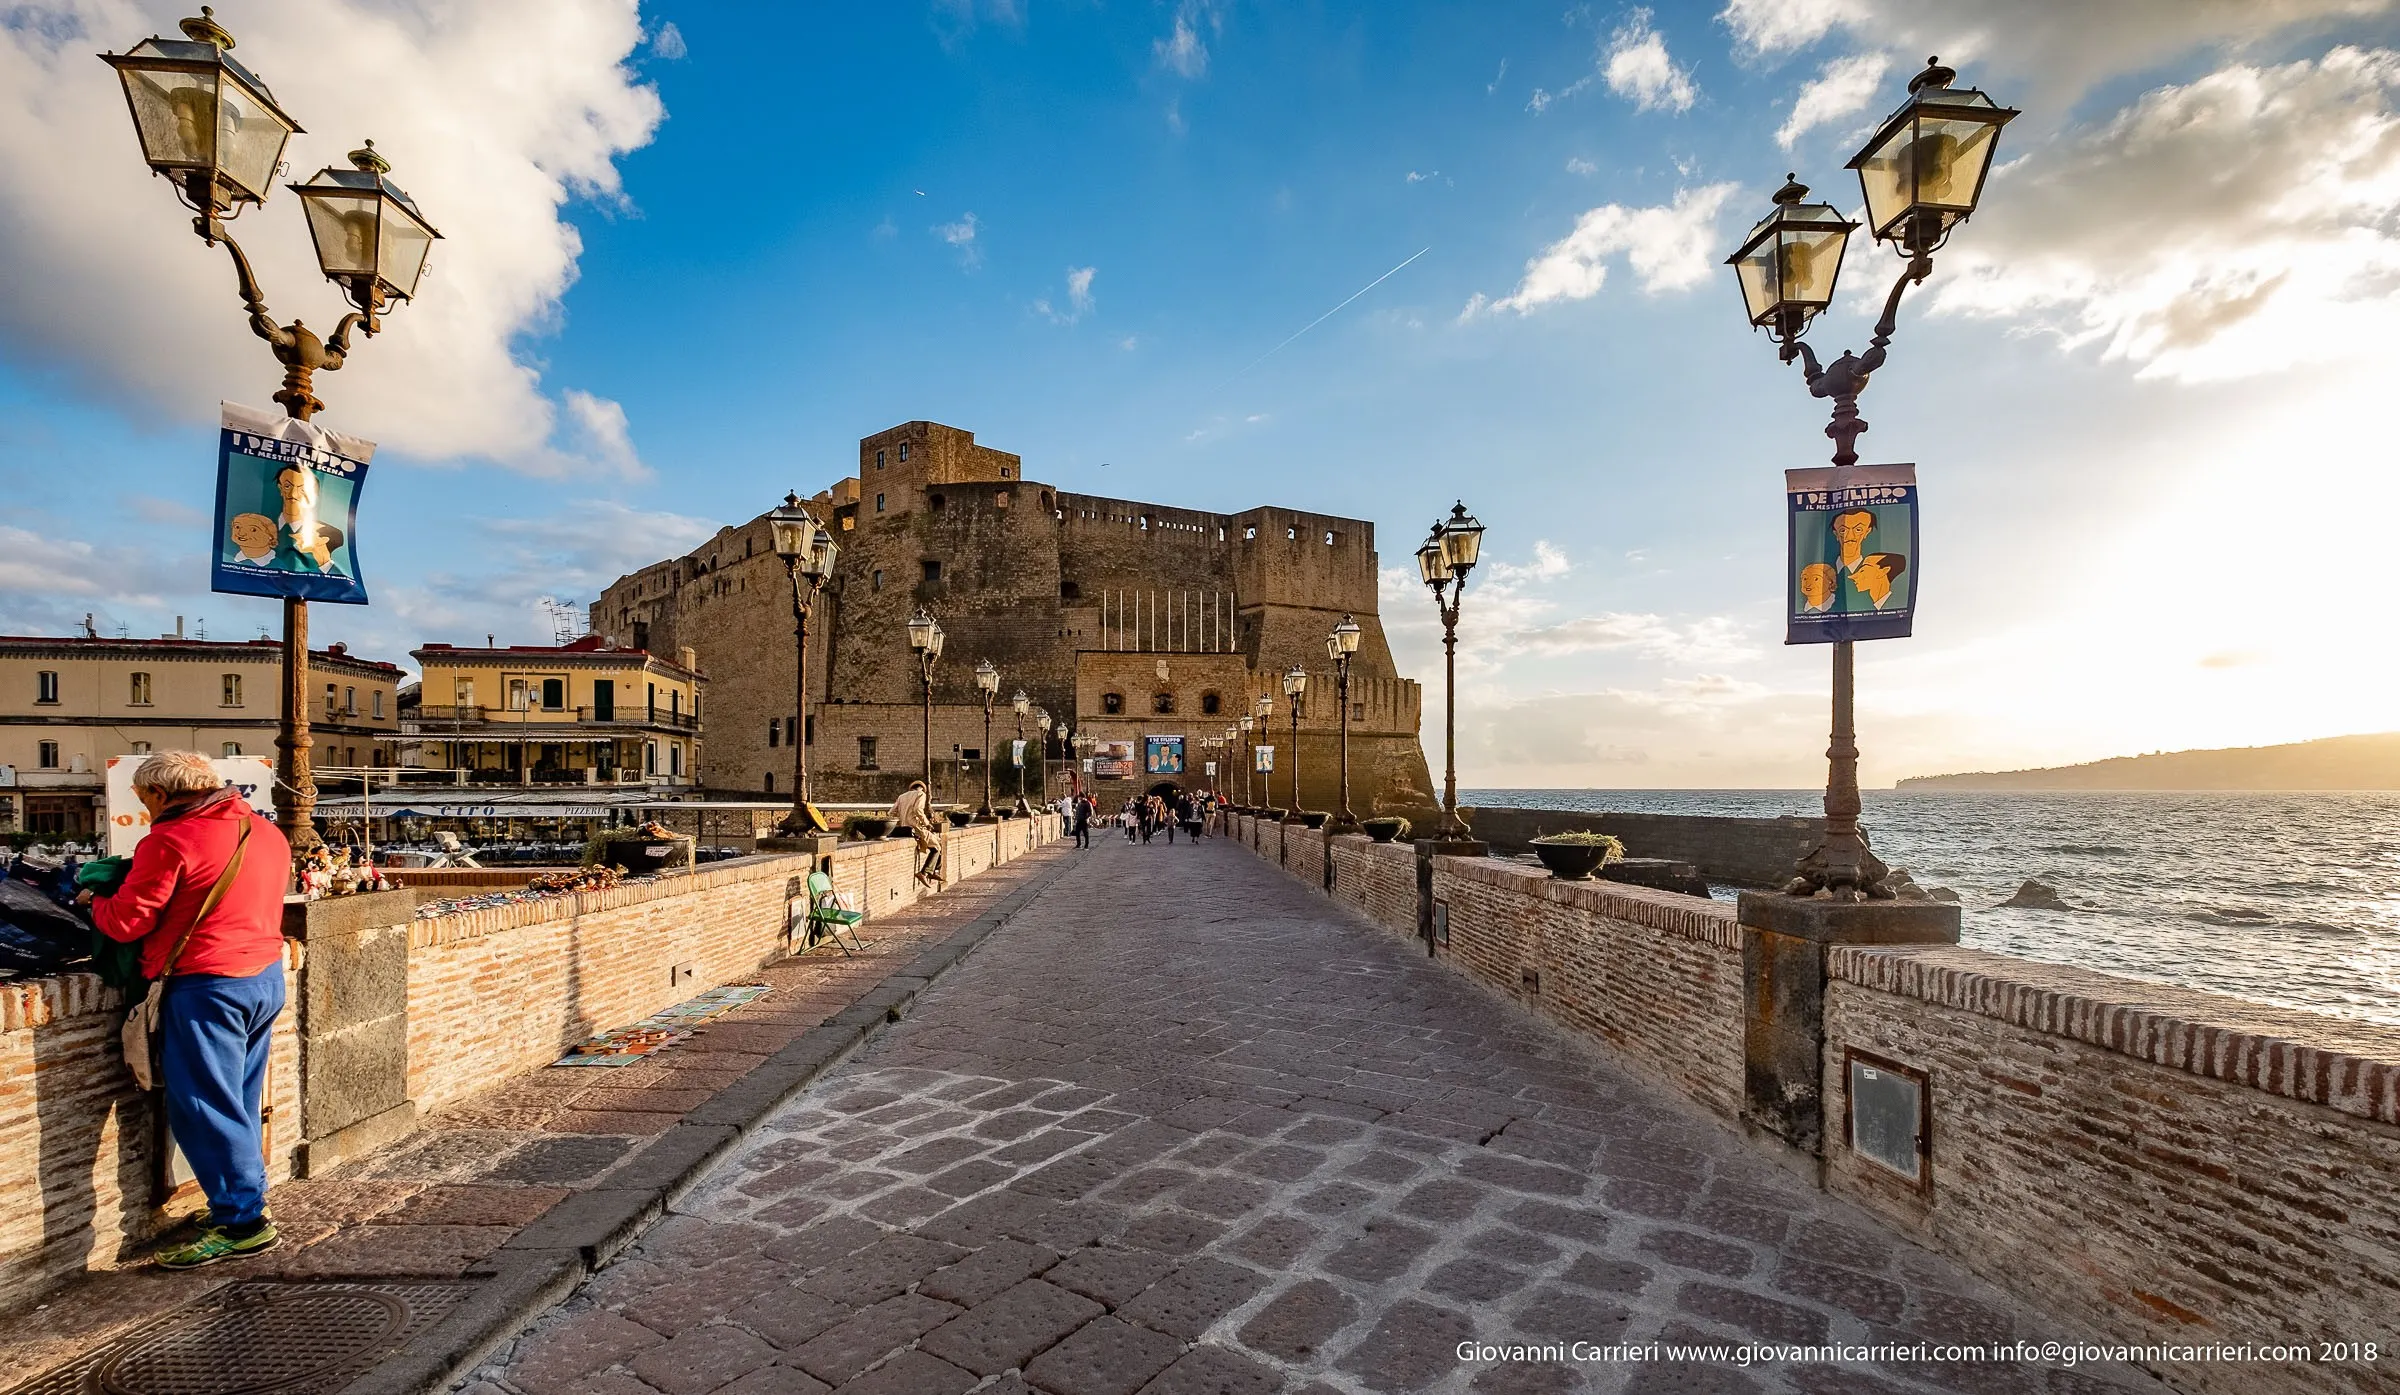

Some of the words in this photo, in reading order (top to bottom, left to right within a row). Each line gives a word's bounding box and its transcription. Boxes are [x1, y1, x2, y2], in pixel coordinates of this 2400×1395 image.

[233, 433, 241, 446] I
[248, 435, 274, 452] DE
[280, 442, 357, 473] FILIPPO
[243, 447, 254, 455] IL
[316, 464, 345, 477] SCENA
[1796, 494, 1802, 505] I
[1807, 492, 1827, 504] DE
[1832, 487, 1907, 503] FILIPPO
[317, 807, 388, 816] RISTORANTE
[564, 807, 607, 815] PIZZERIA
